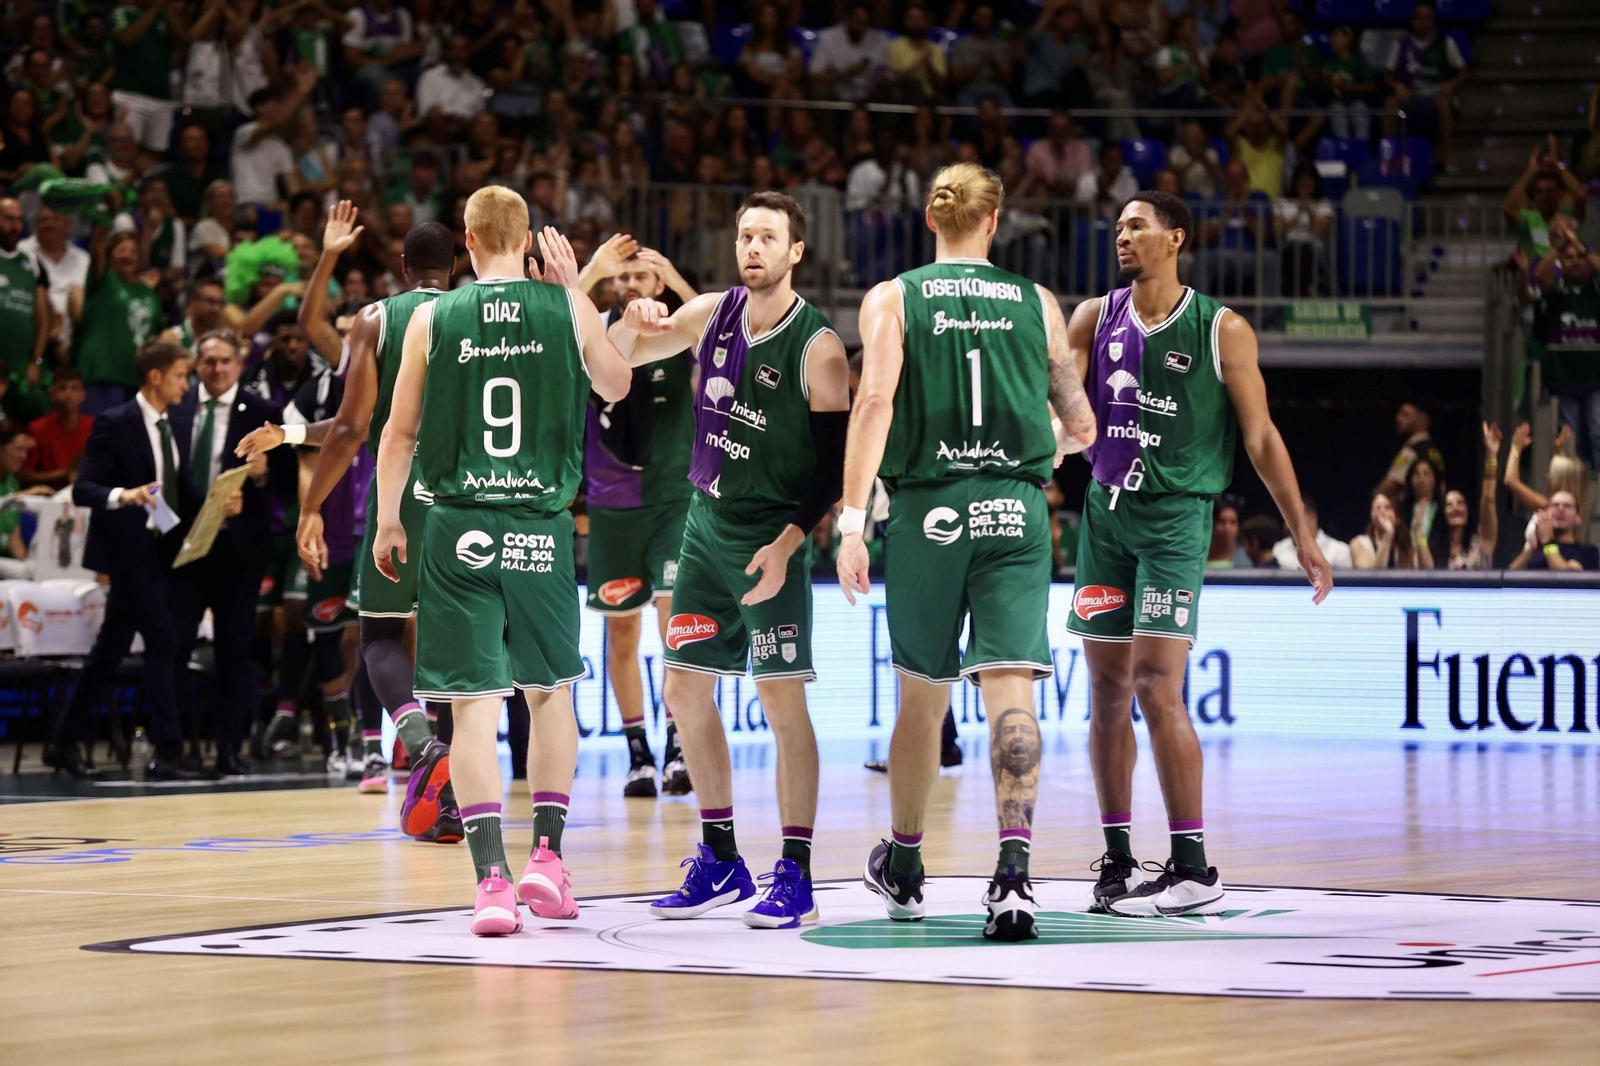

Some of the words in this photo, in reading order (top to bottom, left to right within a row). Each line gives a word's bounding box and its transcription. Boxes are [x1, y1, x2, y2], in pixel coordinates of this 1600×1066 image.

[921, 277, 1023, 303] OSETKOWSKI
[483, 298, 521, 323] DÍAZ
[965, 348, 983, 427] 1
[482, 376, 522, 458] 9
[1107, 420, 1162, 448] málga
[705, 429, 751, 460] máaga
[463, 469, 545, 490] Andalucía
[968, 498, 1026, 515] COSTA
[968, 514, 997, 528] DEL
[998, 513, 1026, 526] SOL
[503, 532, 556, 549] COSTA
[970, 525, 1024, 540] MÁLAGA
[502, 548, 528, 561] DEL
[530, 550, 555, 562] SOL
[500, 559, 553, 573] MÁLAGA
[1146, 588, 1174, 605] má
[1141, 599, 1173, 619] laga
[1400, 607, 1600, 733] Fuen
